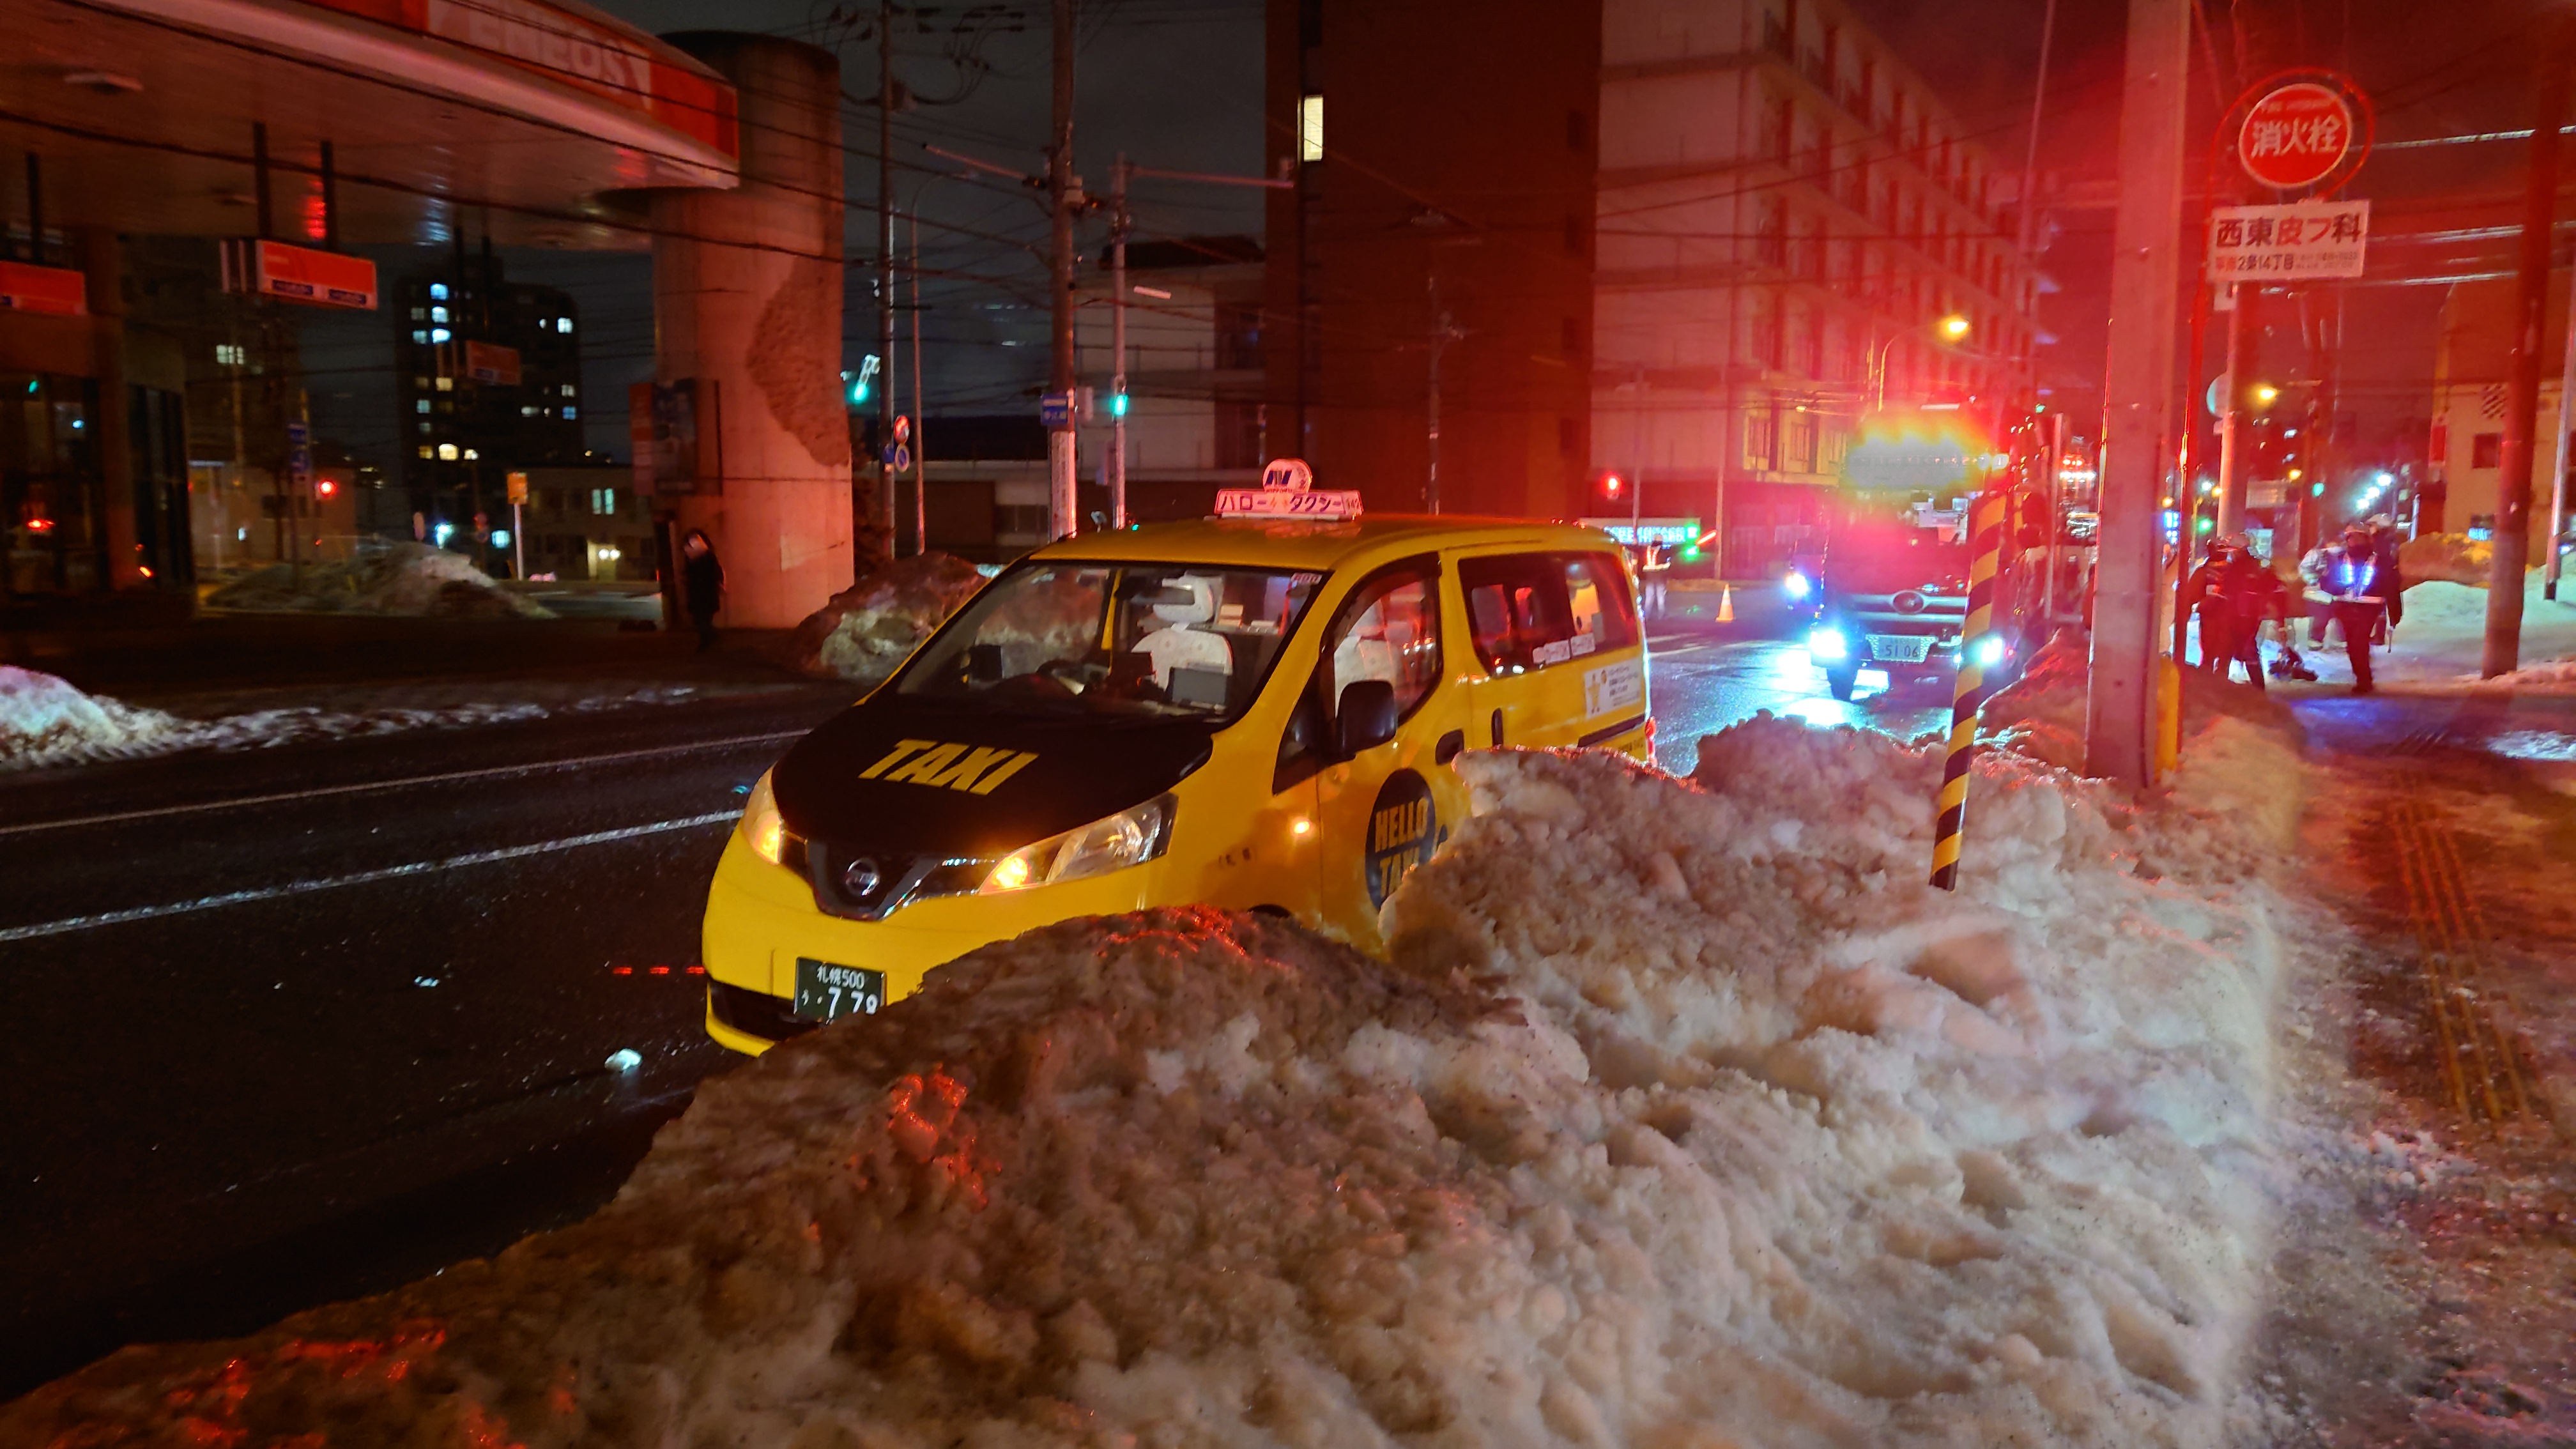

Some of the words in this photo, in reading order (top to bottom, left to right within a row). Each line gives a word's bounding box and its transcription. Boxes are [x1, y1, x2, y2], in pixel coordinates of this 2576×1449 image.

[2251, 114, 2342, 158] 消火栓
[2216, 213, 2361, 248] 西東皮フ科
[1220, 495, 1267, 510] ハロー
[1289, 495, 1341, 512] タクシー
[857, 738, 1040, 795] TAXI
[1375, 797, 1429, 853] HELLO
[816, 965, 865, 990] 札幌500
